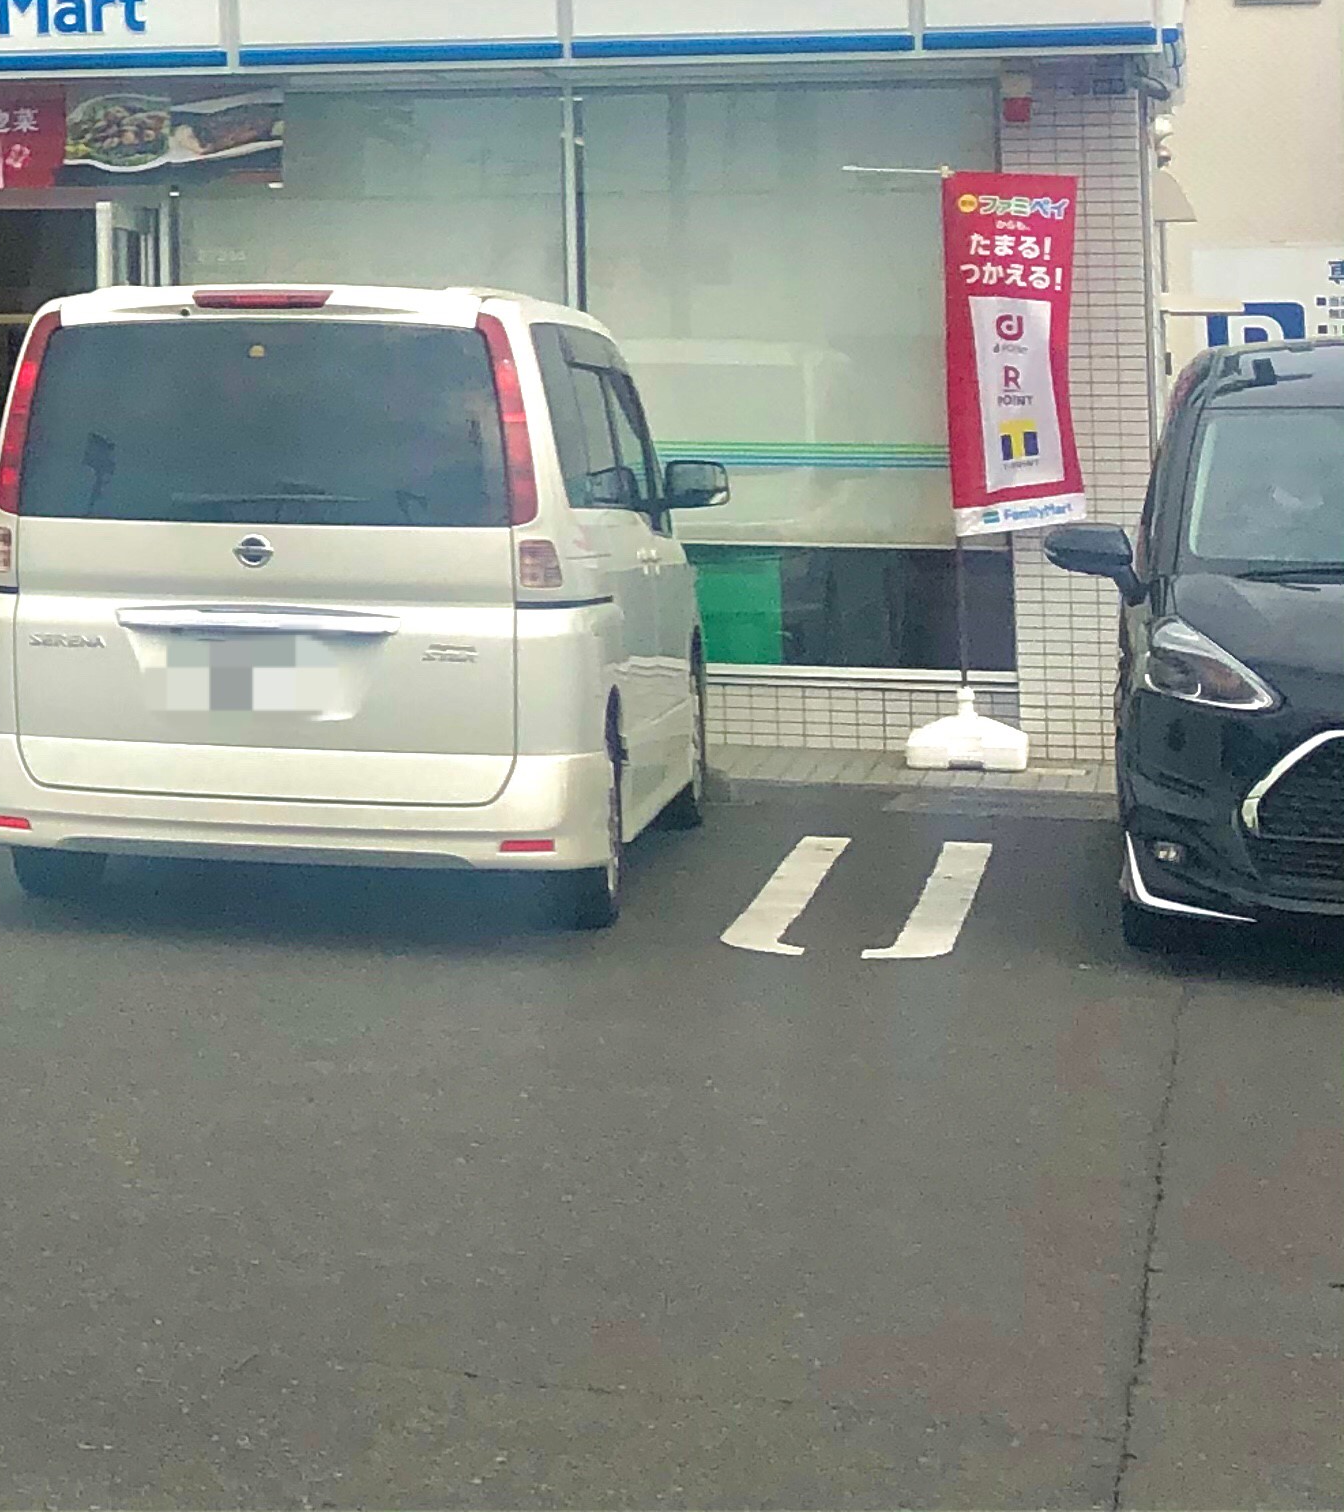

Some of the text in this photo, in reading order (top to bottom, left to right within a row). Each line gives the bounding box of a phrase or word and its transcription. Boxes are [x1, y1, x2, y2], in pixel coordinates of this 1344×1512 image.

[978, 194, 1070, 220] ファミペイ
[969, 232, 1052, 261] たまる!
[960, 262, 1063, 291] つかえる!
[997, 394, 1034, 407] POINT
[1003, 502, 1073, 521] FamilyMart
